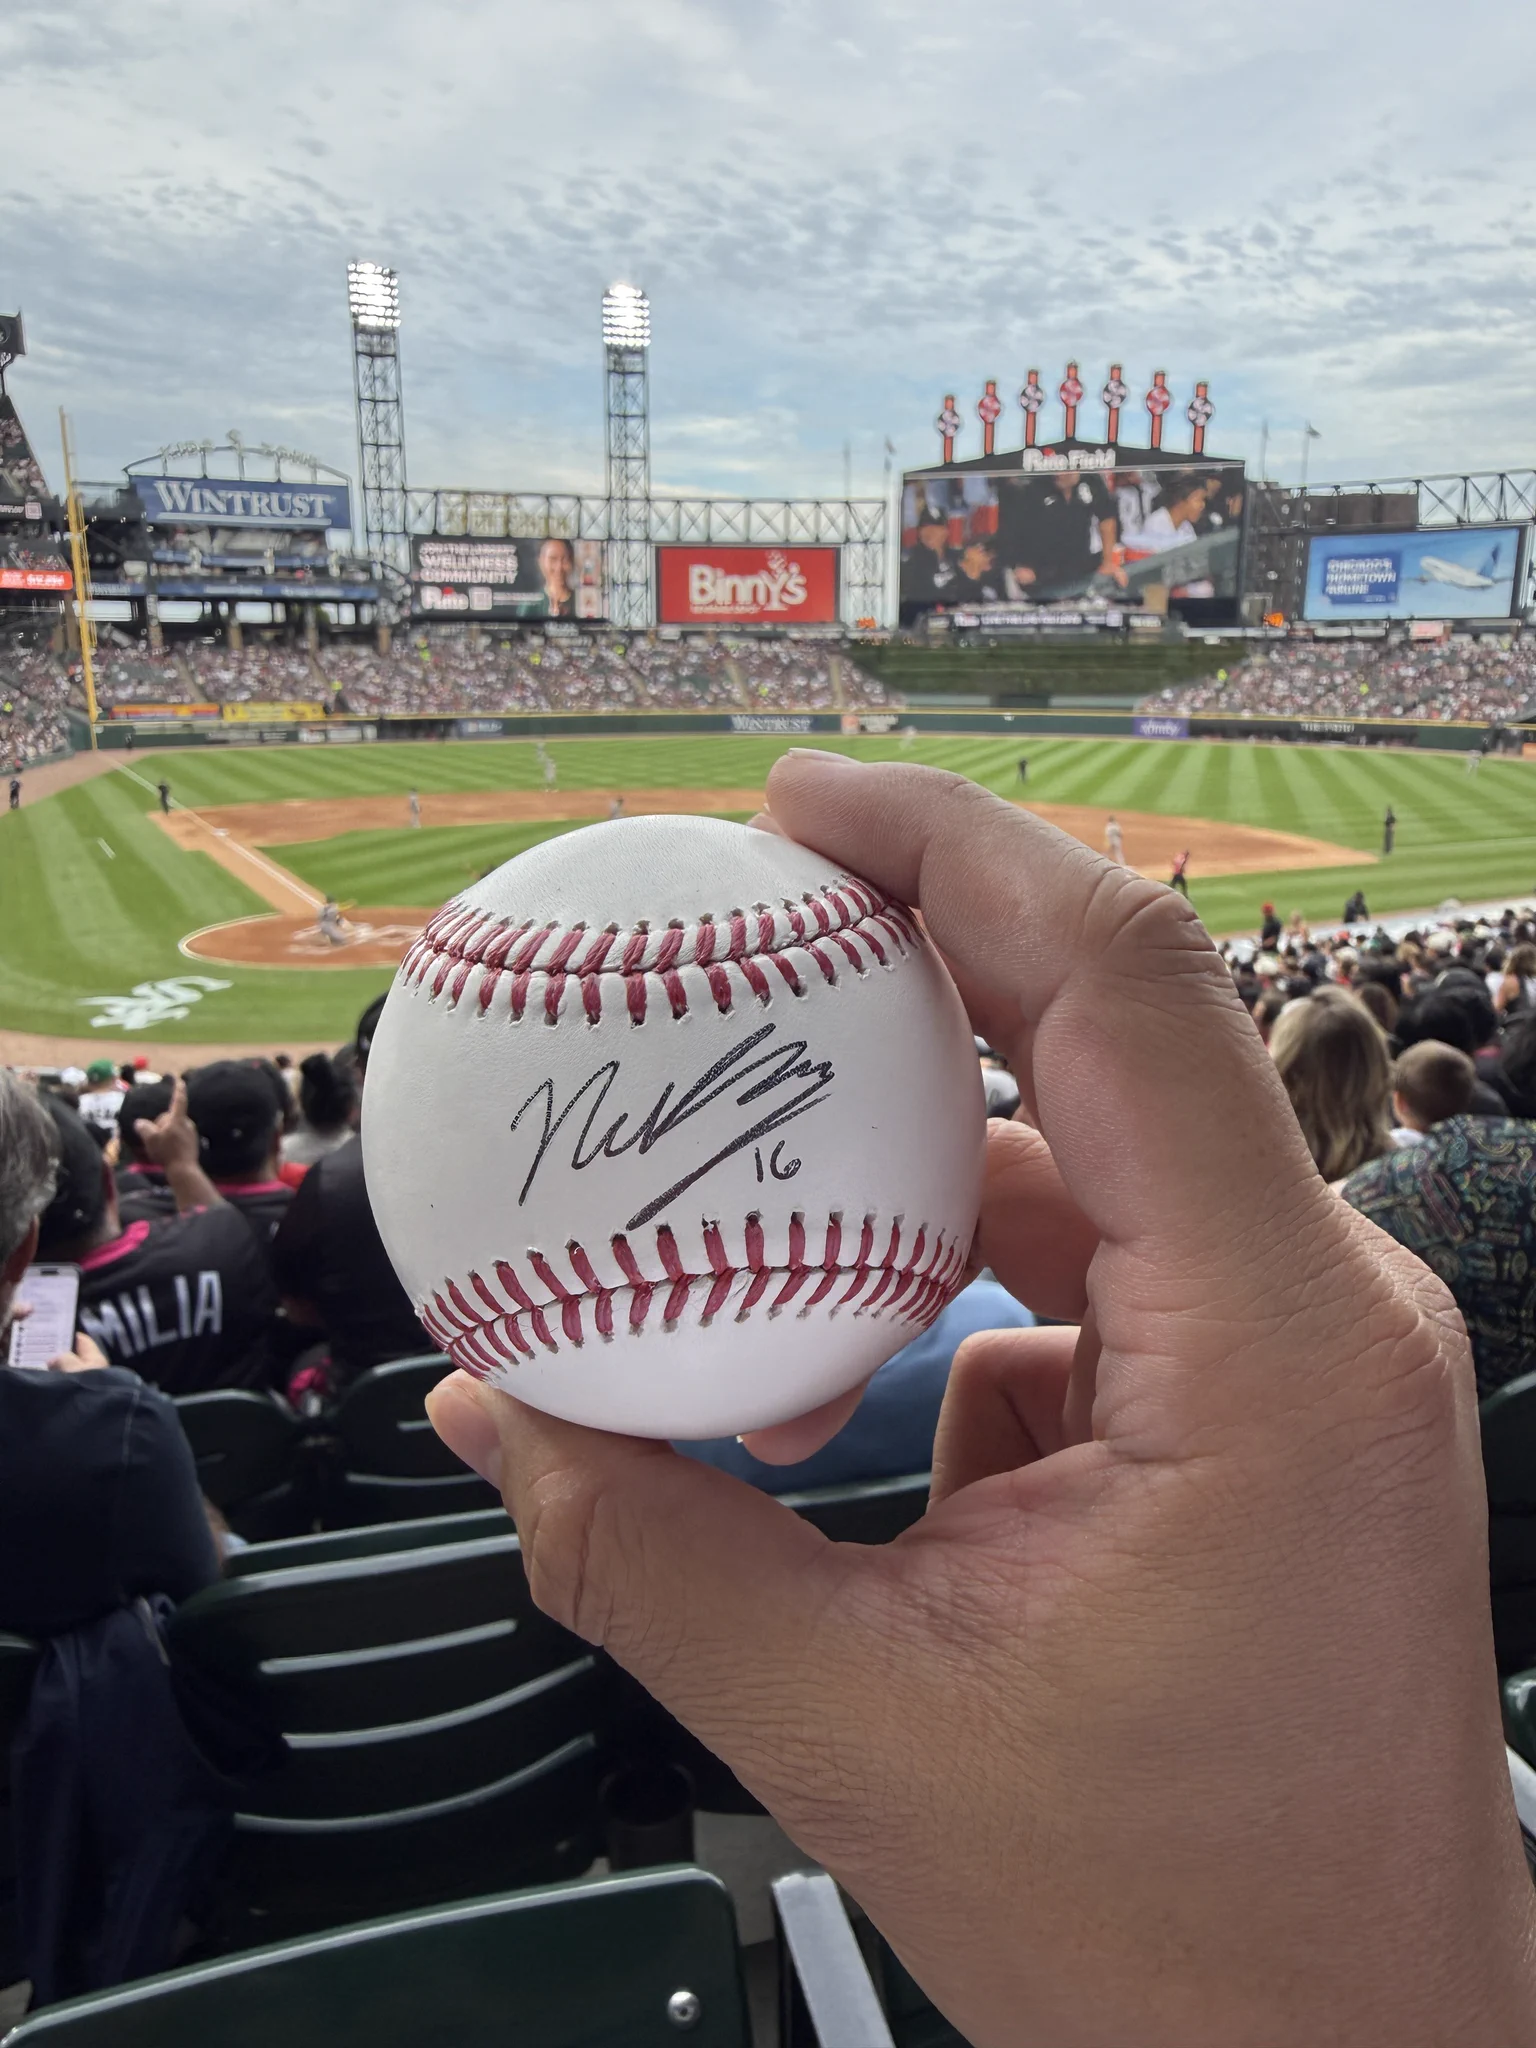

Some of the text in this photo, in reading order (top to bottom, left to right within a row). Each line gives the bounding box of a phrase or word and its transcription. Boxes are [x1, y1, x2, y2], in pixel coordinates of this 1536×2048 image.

[154, 481, 336, 518] WINTRUST
[419, 554, 518, 570] WELLNESS
[1326, 571, 1397, 583] HOMETOWN
[755, 1139, 802, 1183] 16
